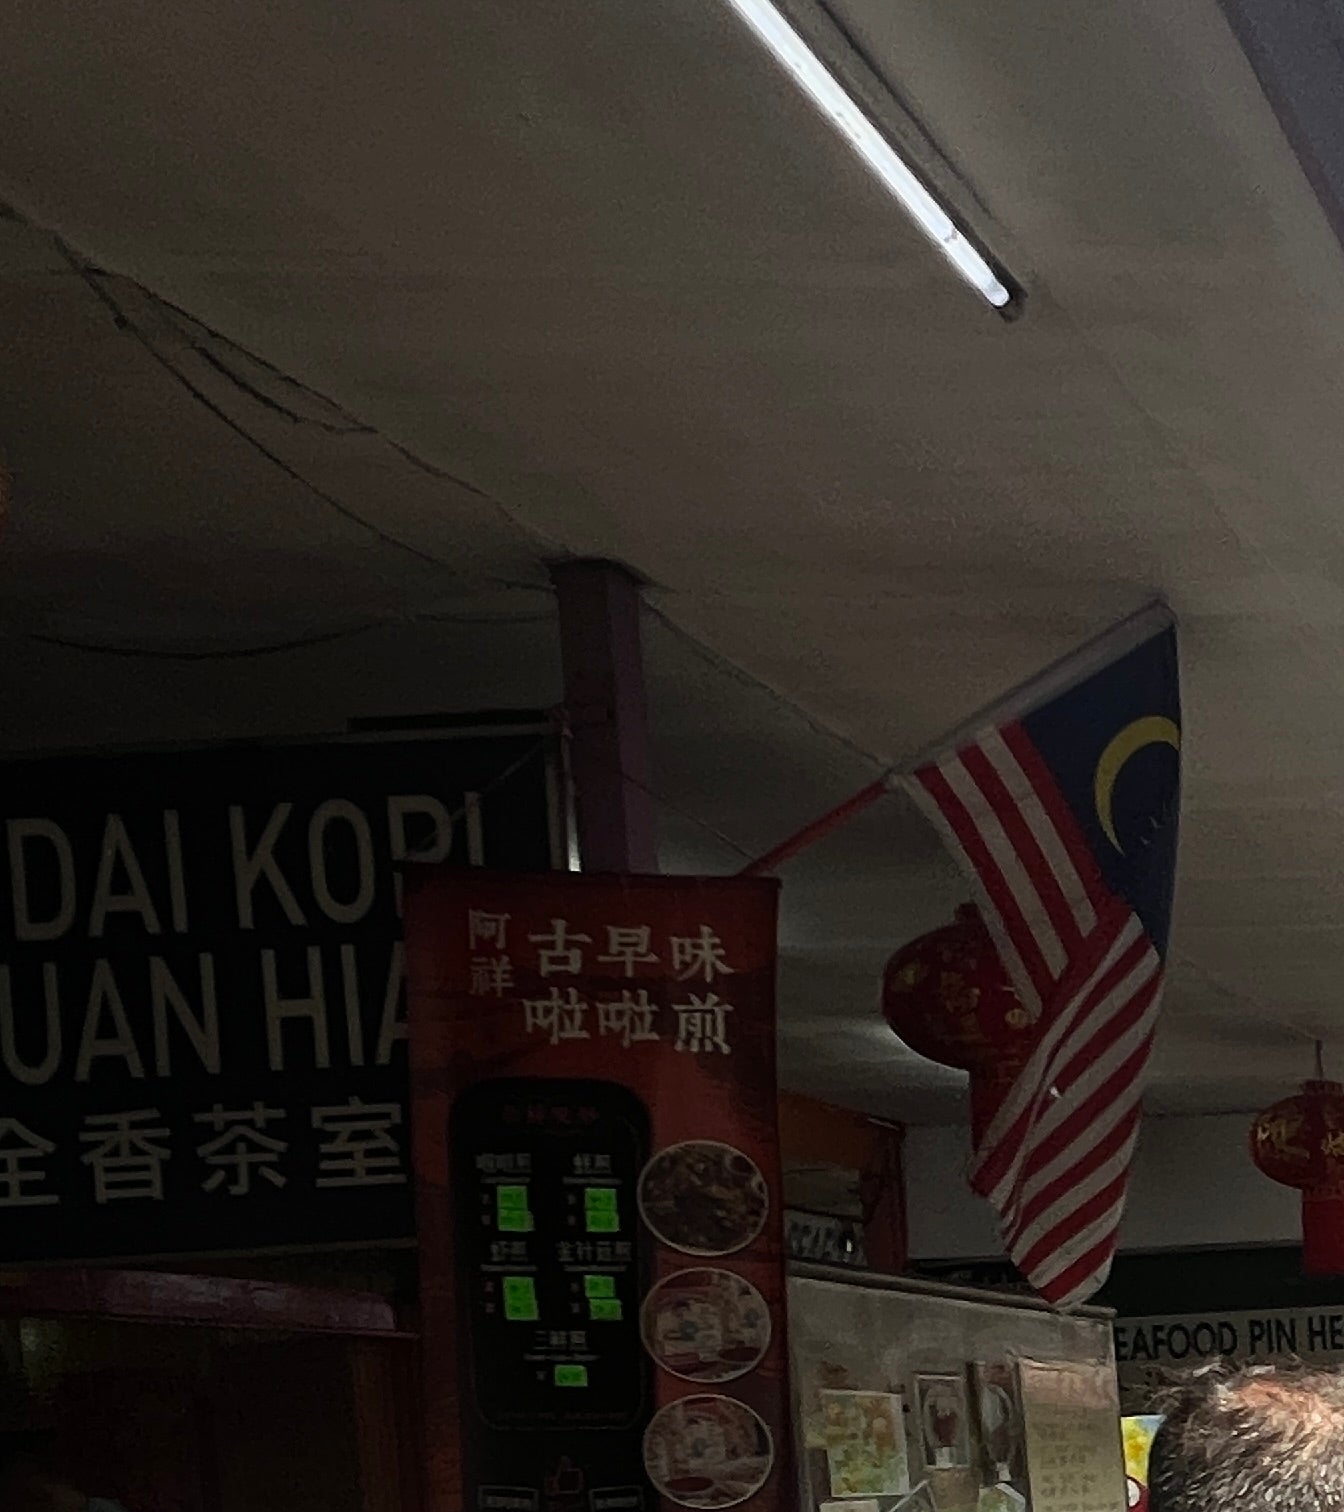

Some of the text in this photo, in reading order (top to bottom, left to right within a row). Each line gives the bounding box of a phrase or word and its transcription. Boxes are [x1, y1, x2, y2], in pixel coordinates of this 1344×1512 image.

[5, 809, 191, 943] DAI
[527, 917, 736, 984] 古早味
[521, 986, 734, 1056] 啦啦煎
[1249, 1317, 1297, 1357] PIN
